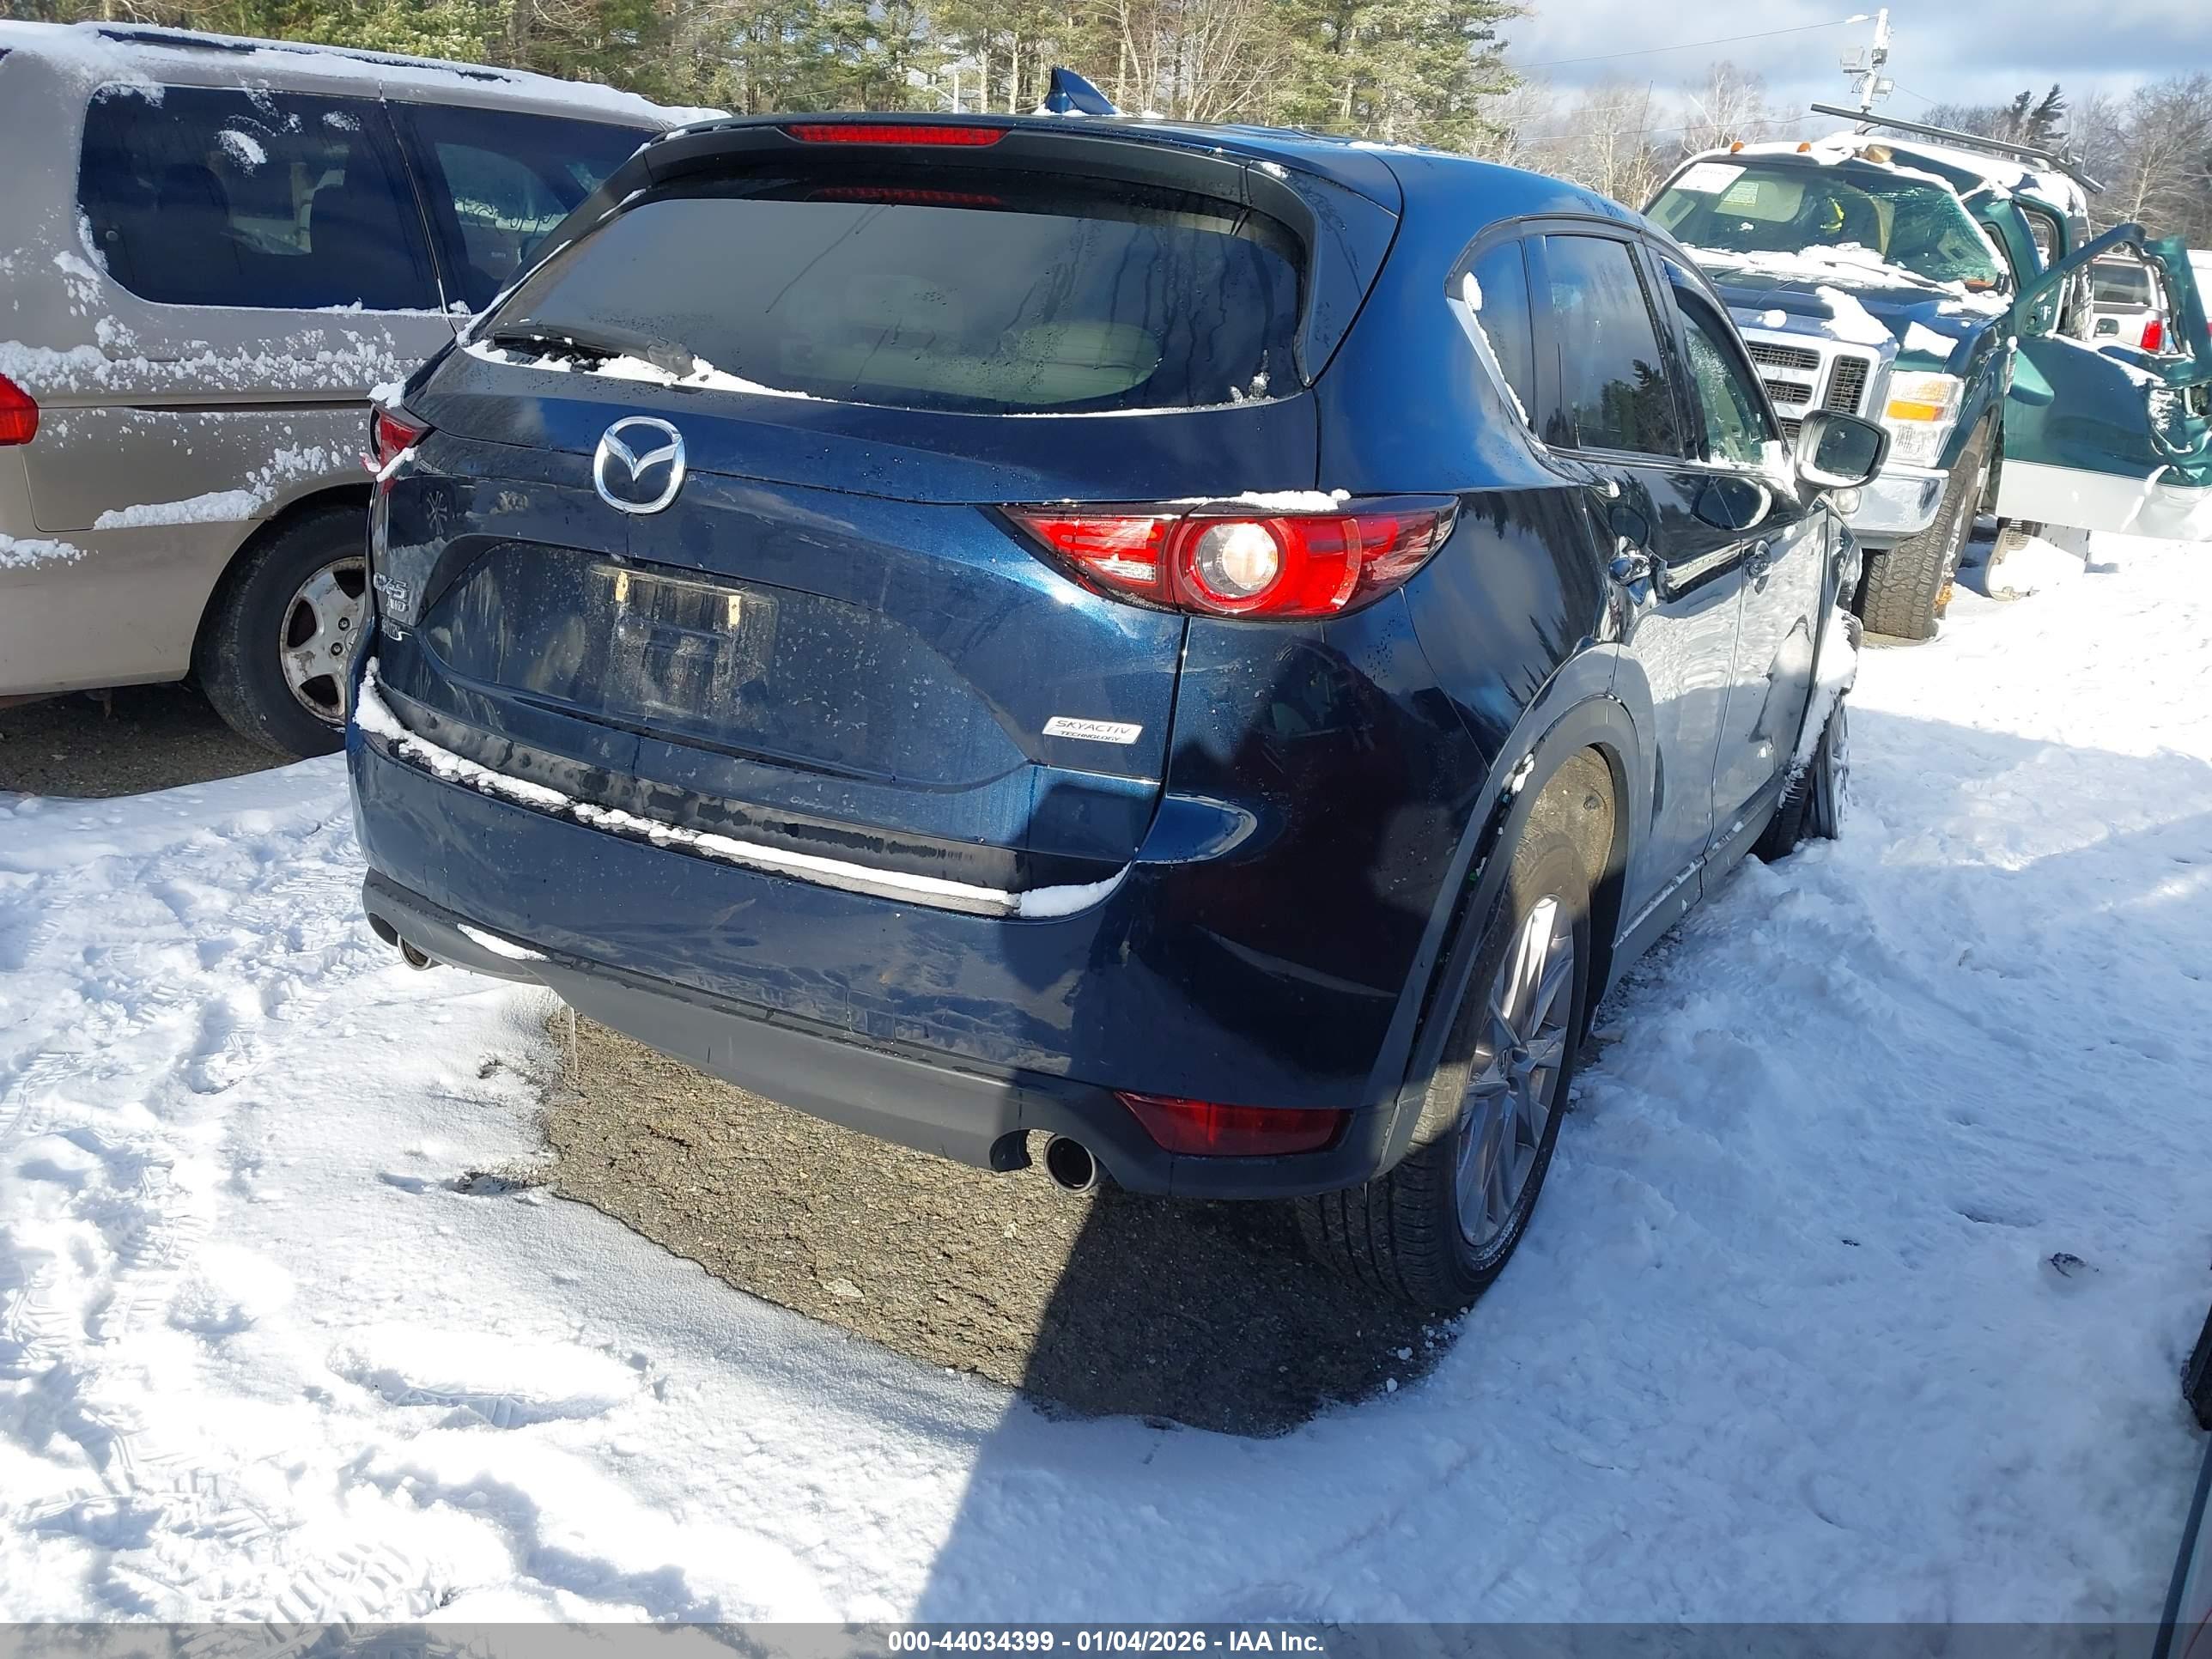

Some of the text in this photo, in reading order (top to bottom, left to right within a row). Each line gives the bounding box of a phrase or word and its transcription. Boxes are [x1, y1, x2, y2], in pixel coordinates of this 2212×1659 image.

[374, 572, 407, 599] CX-5
[1055, 720, 1131, 734] SKYACTIV
[1060, 731, 1121, 741] TECHNOLOGY
